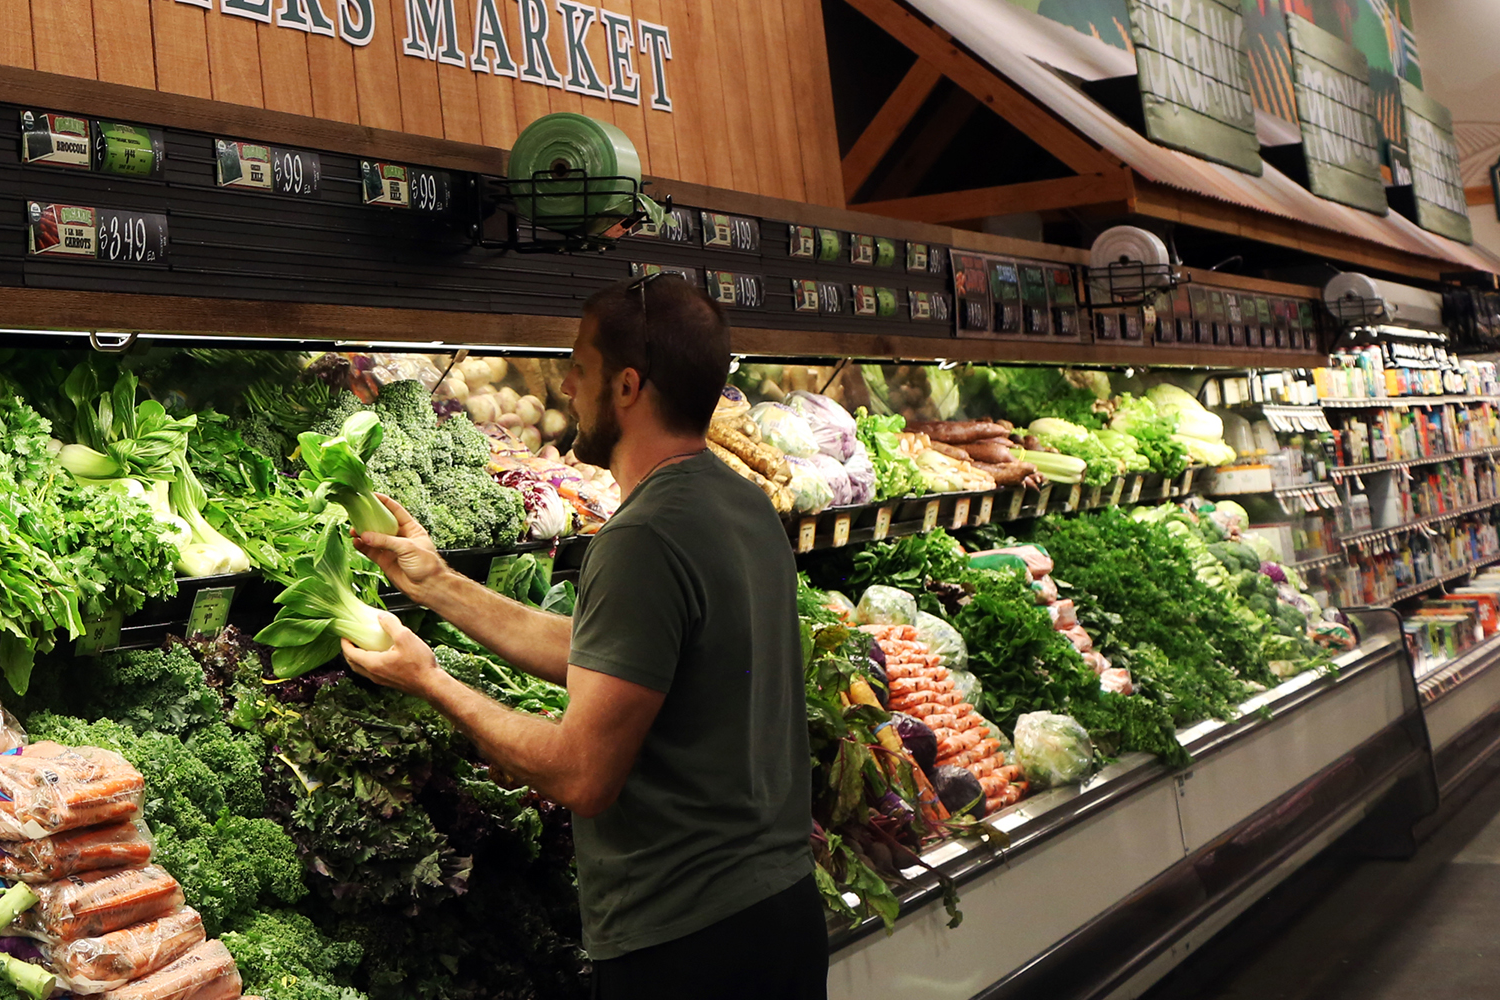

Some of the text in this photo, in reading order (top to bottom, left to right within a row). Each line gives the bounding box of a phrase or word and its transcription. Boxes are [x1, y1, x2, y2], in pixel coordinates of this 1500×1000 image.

[56, 141, 87, 155] BROCCOLI
[65, 236, 92, 249] CARROTS
[99, 216, 146, 261] $3.49
